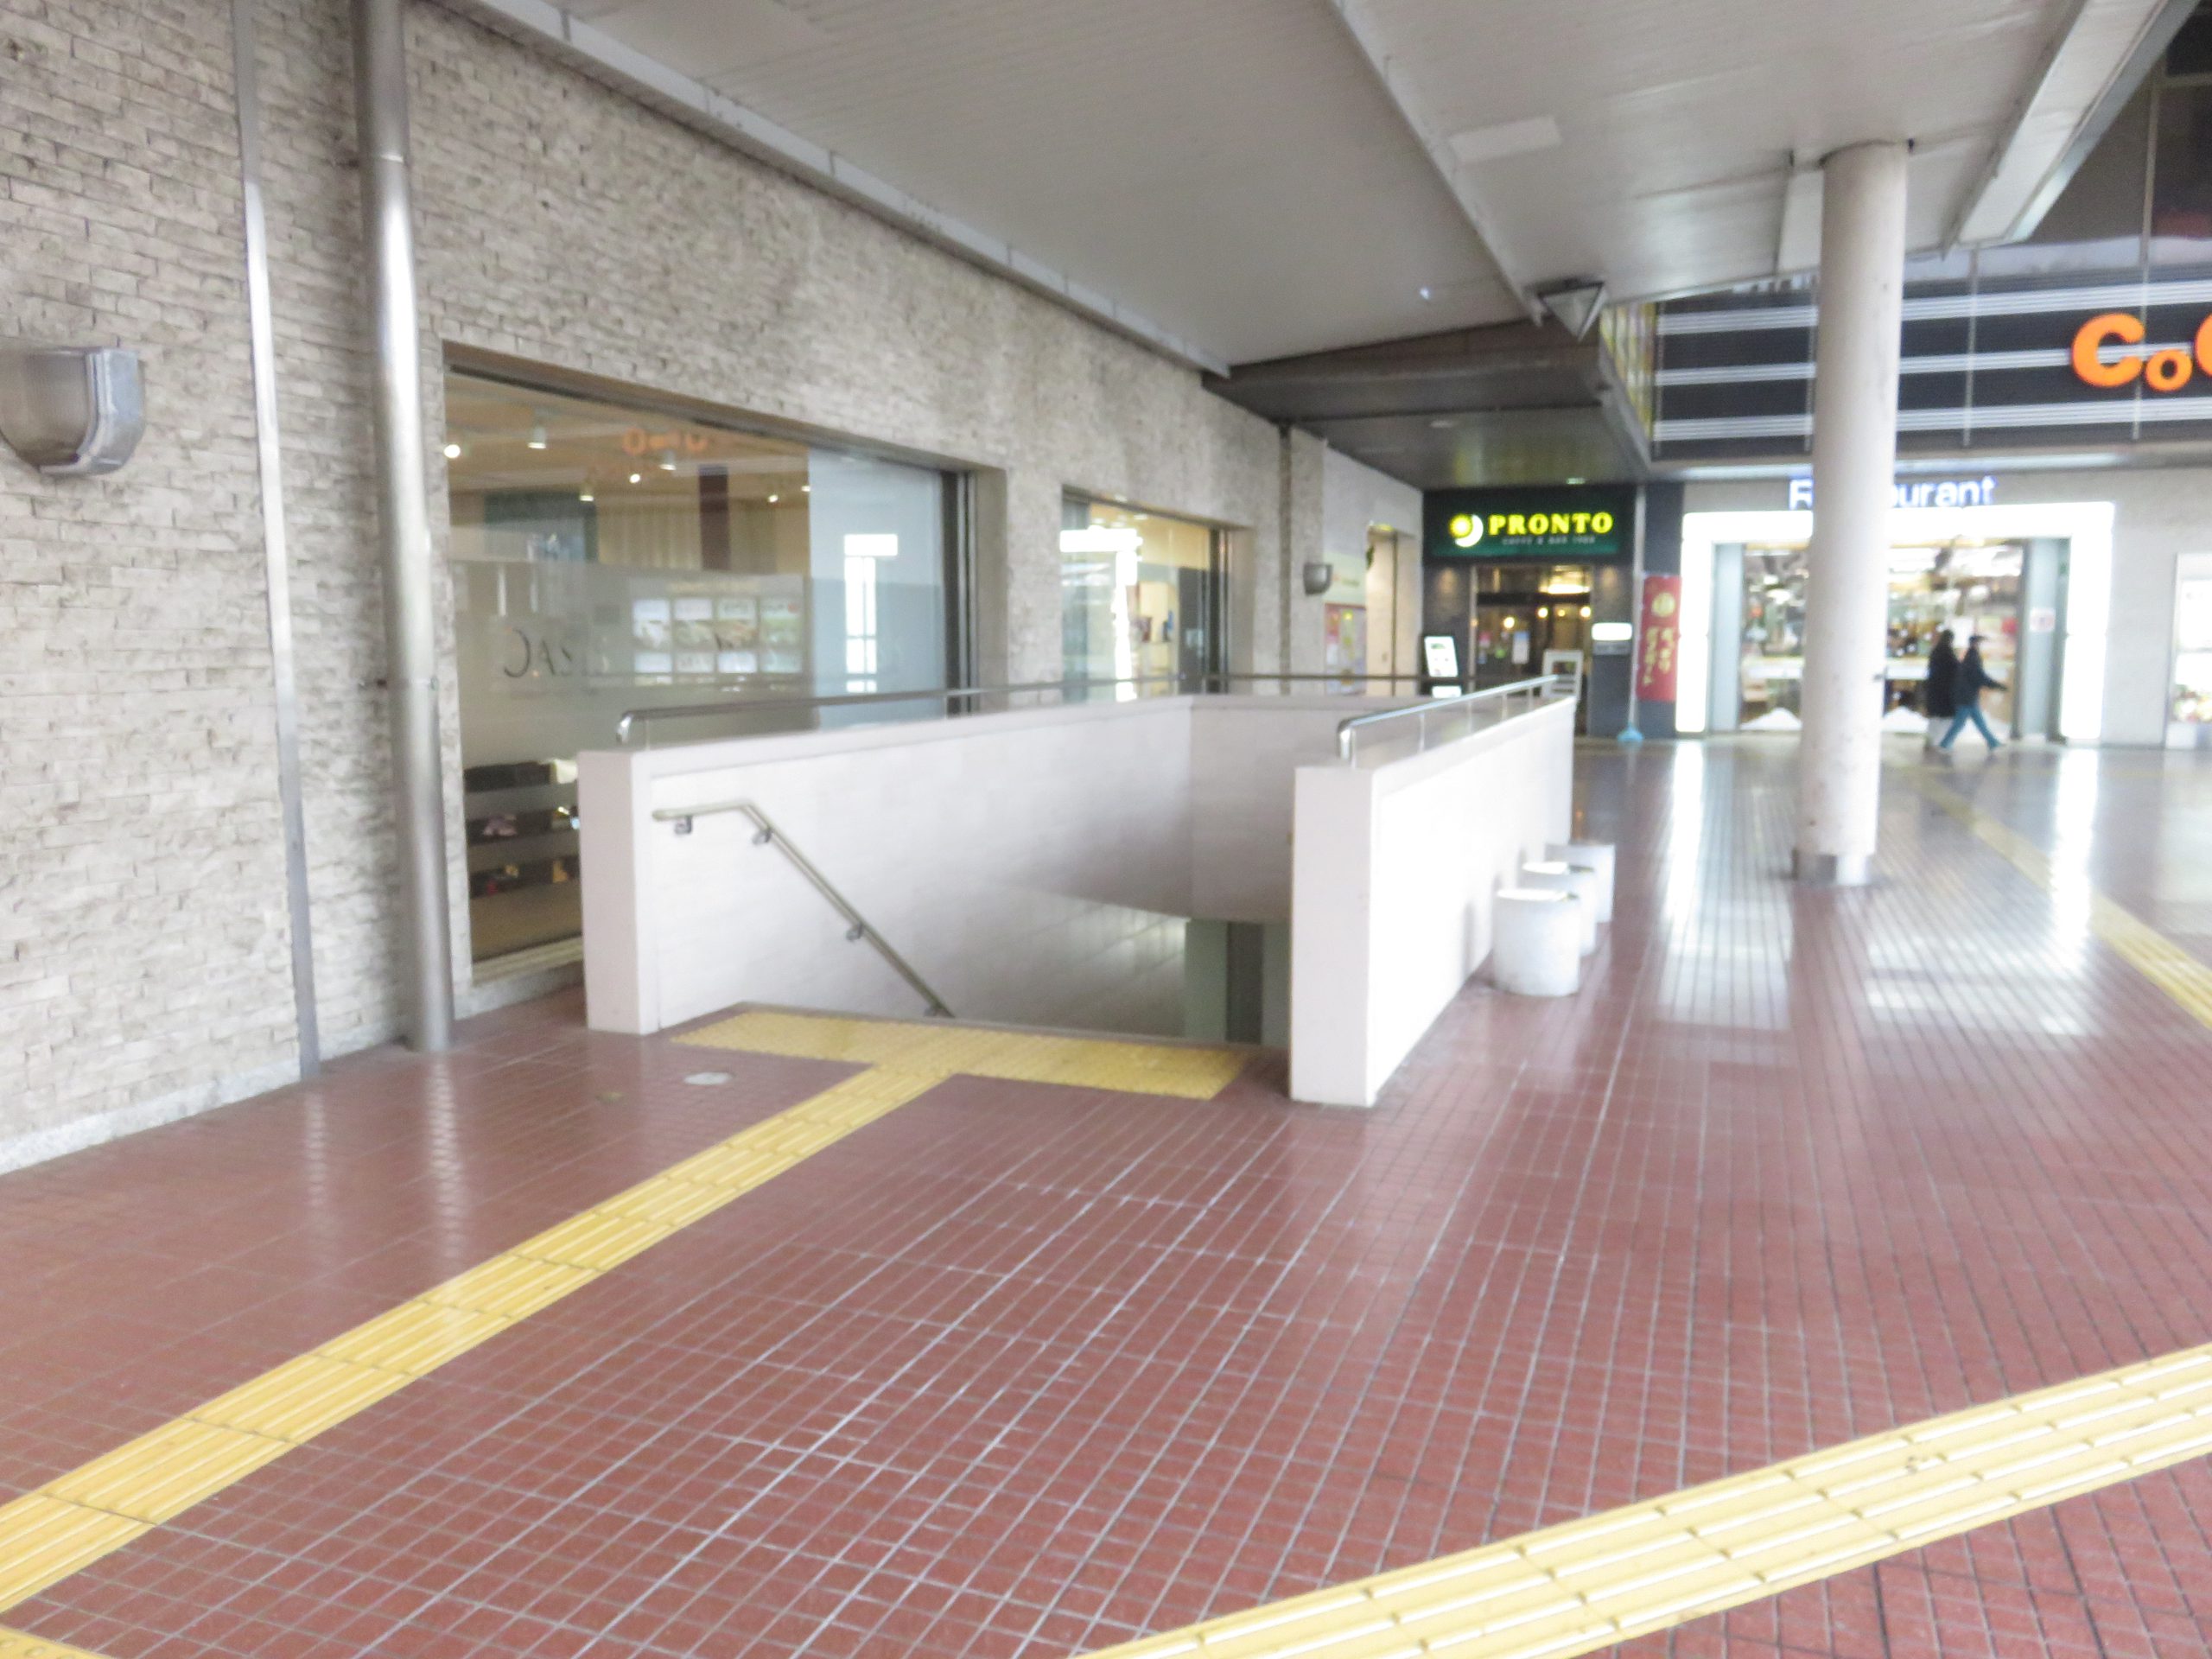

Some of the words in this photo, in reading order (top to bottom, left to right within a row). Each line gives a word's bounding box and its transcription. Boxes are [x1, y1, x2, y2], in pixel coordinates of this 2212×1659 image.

[2072, 312, 2212, 391] Co
[1789, 475, 1995, 510] Rurant
[1489, 512, 1613, 536] PRONTO
